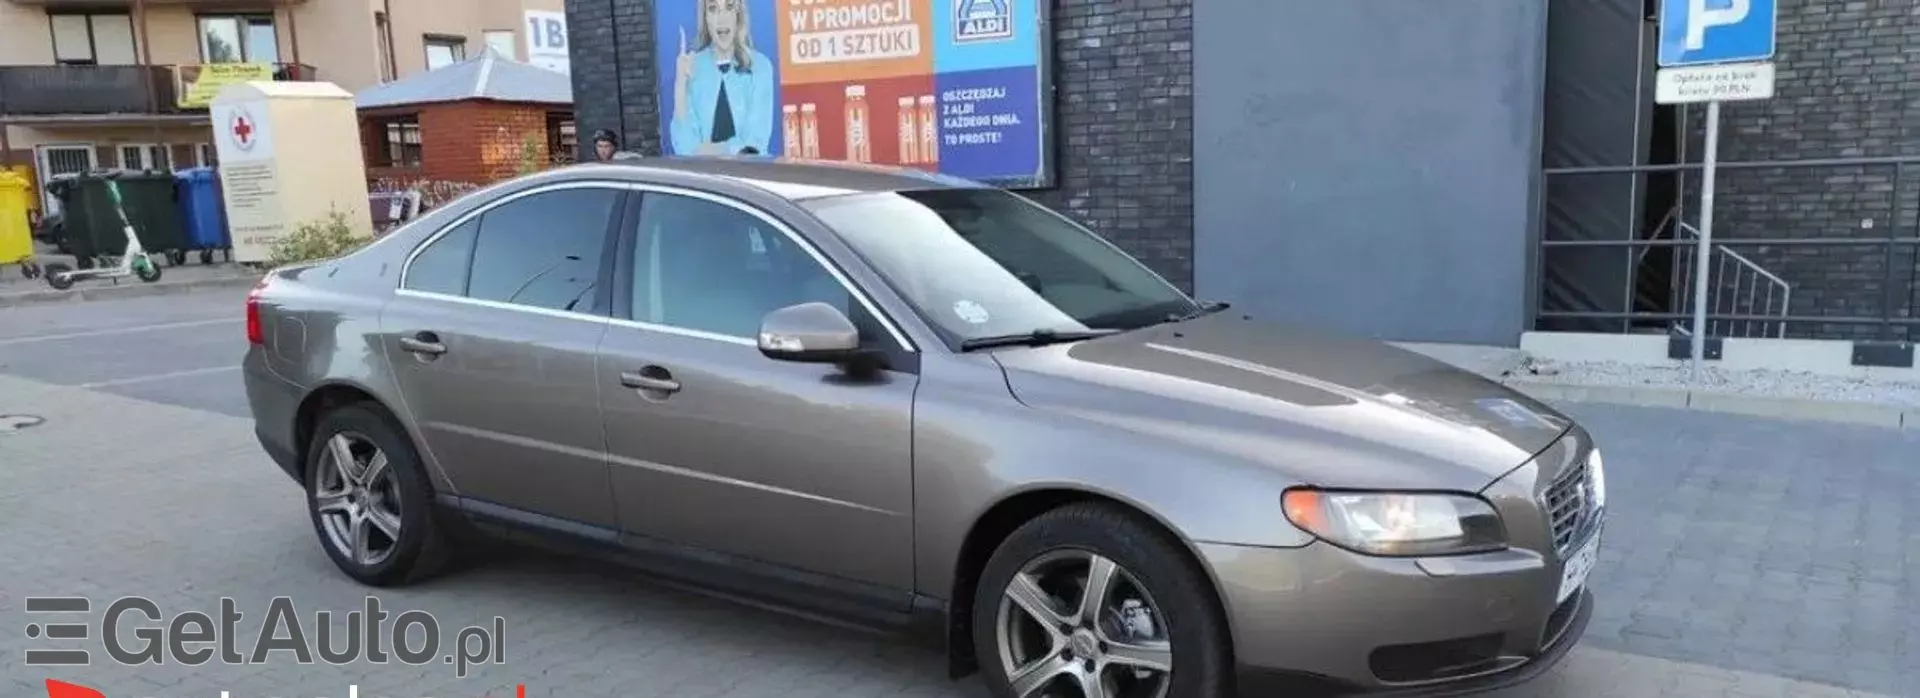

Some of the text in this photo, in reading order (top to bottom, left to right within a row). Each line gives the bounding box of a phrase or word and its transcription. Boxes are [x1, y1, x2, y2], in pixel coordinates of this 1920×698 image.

[789, 0, 911, 31] W PROMOCJI
[963, 19, 1004, 34] ALDI
[1685, 0, 1750, 50] P
[797, 29, 912, 58] OD 1 SZTUKI
[943, 103, 974, 115] Z ALDI
[992, 112, 1021, 126] DNIA.
[944, 131, 1002, 145] TO PROSTE!
